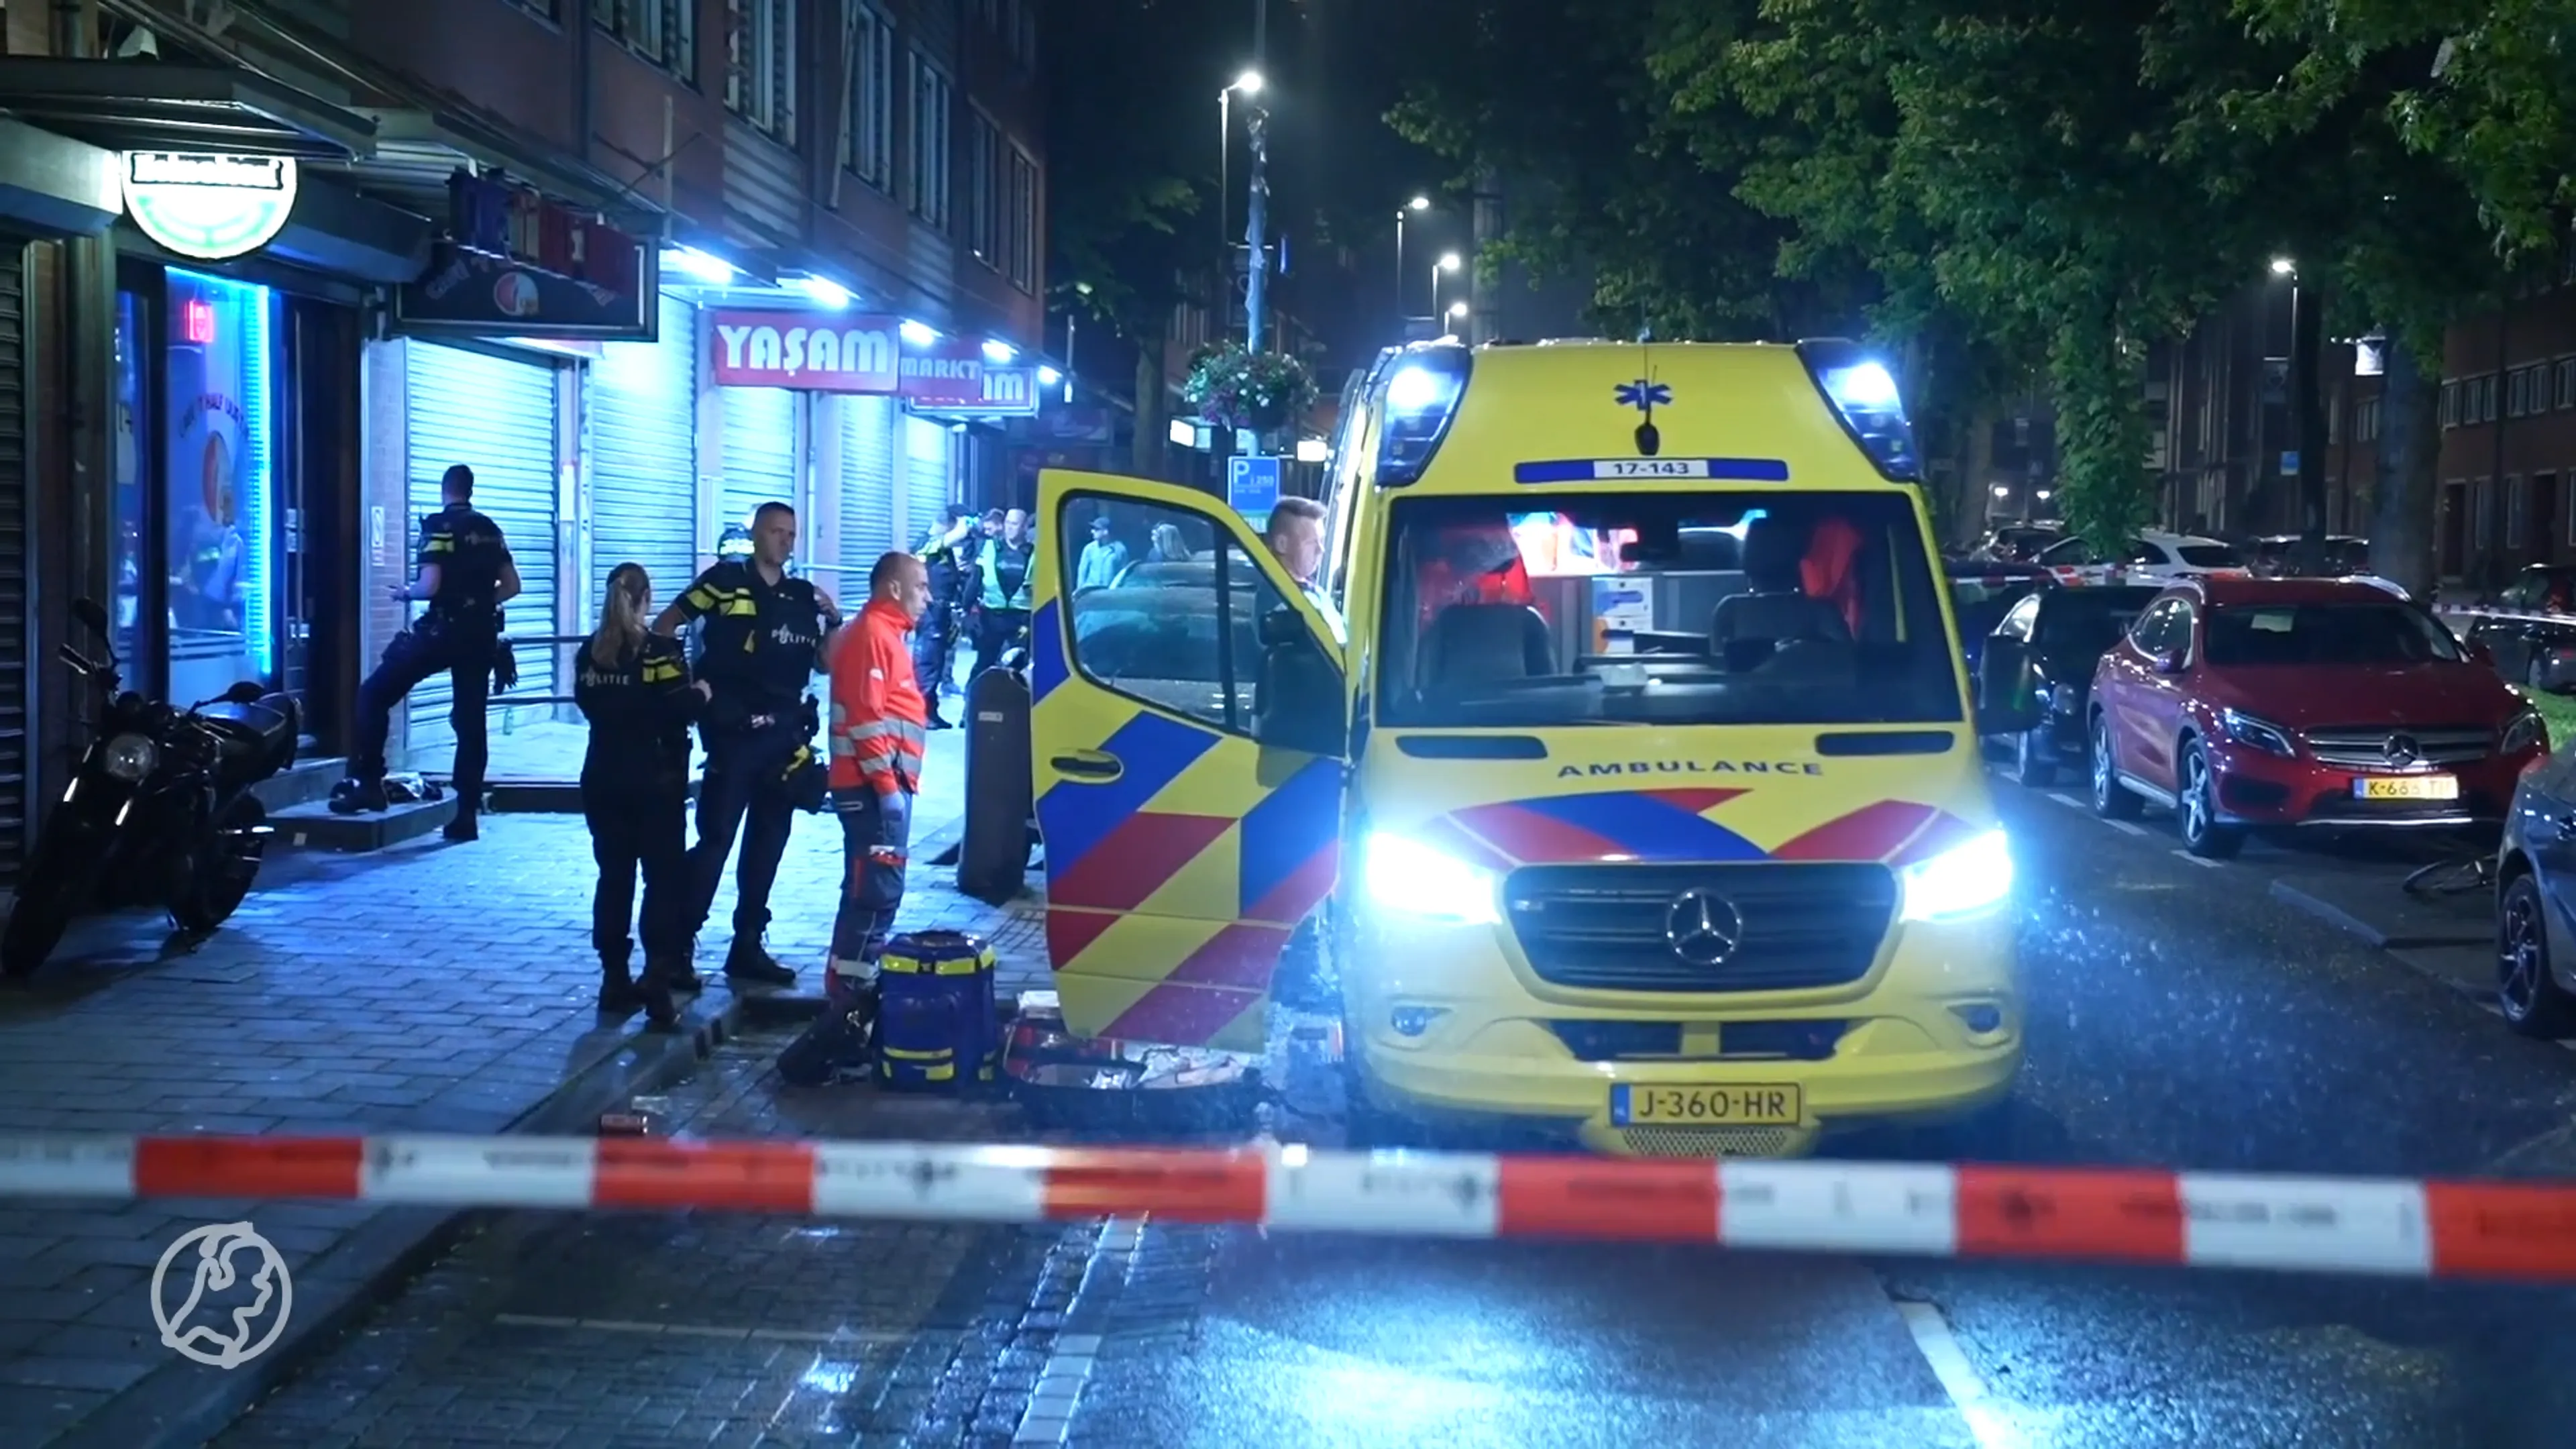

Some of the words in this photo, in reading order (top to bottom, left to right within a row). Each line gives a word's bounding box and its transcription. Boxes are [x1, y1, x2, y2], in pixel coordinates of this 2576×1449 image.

[716, 325, 888, 376] YAŞAM
[900, 357, 981, 380] MARKT
[1233, 460, 1249, 484] P
[1613, 462, 1689, 474] 17-143
[1557, 760, 1824, 777] AMBULANCE
[1639, 1089, 1786, 1118] J-360-HR
